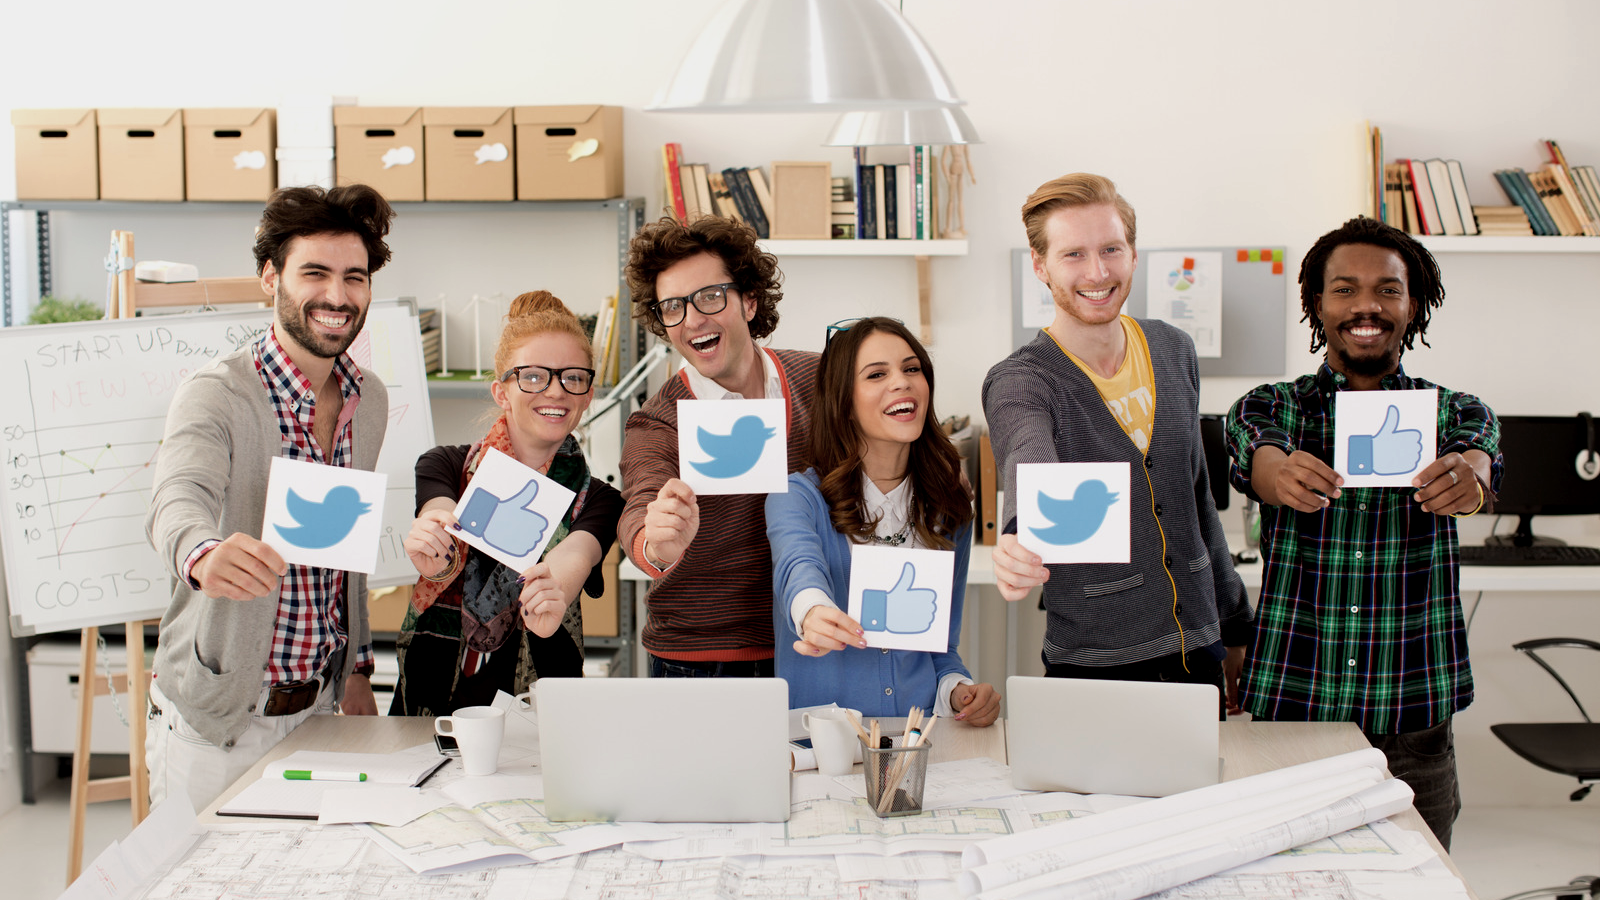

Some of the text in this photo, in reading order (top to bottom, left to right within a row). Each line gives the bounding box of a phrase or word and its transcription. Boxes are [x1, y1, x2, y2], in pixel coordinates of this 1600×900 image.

[37, 327, 172, 367] START UP
[52, 376, 127, 412] NEW
[4, 425, 24, 441] 50
[7, 448, 28, 469] 40
[10, 474, 34, 490] 30
[16, 502, 36, 519] 20
[24, 528, 41, 544] 10
